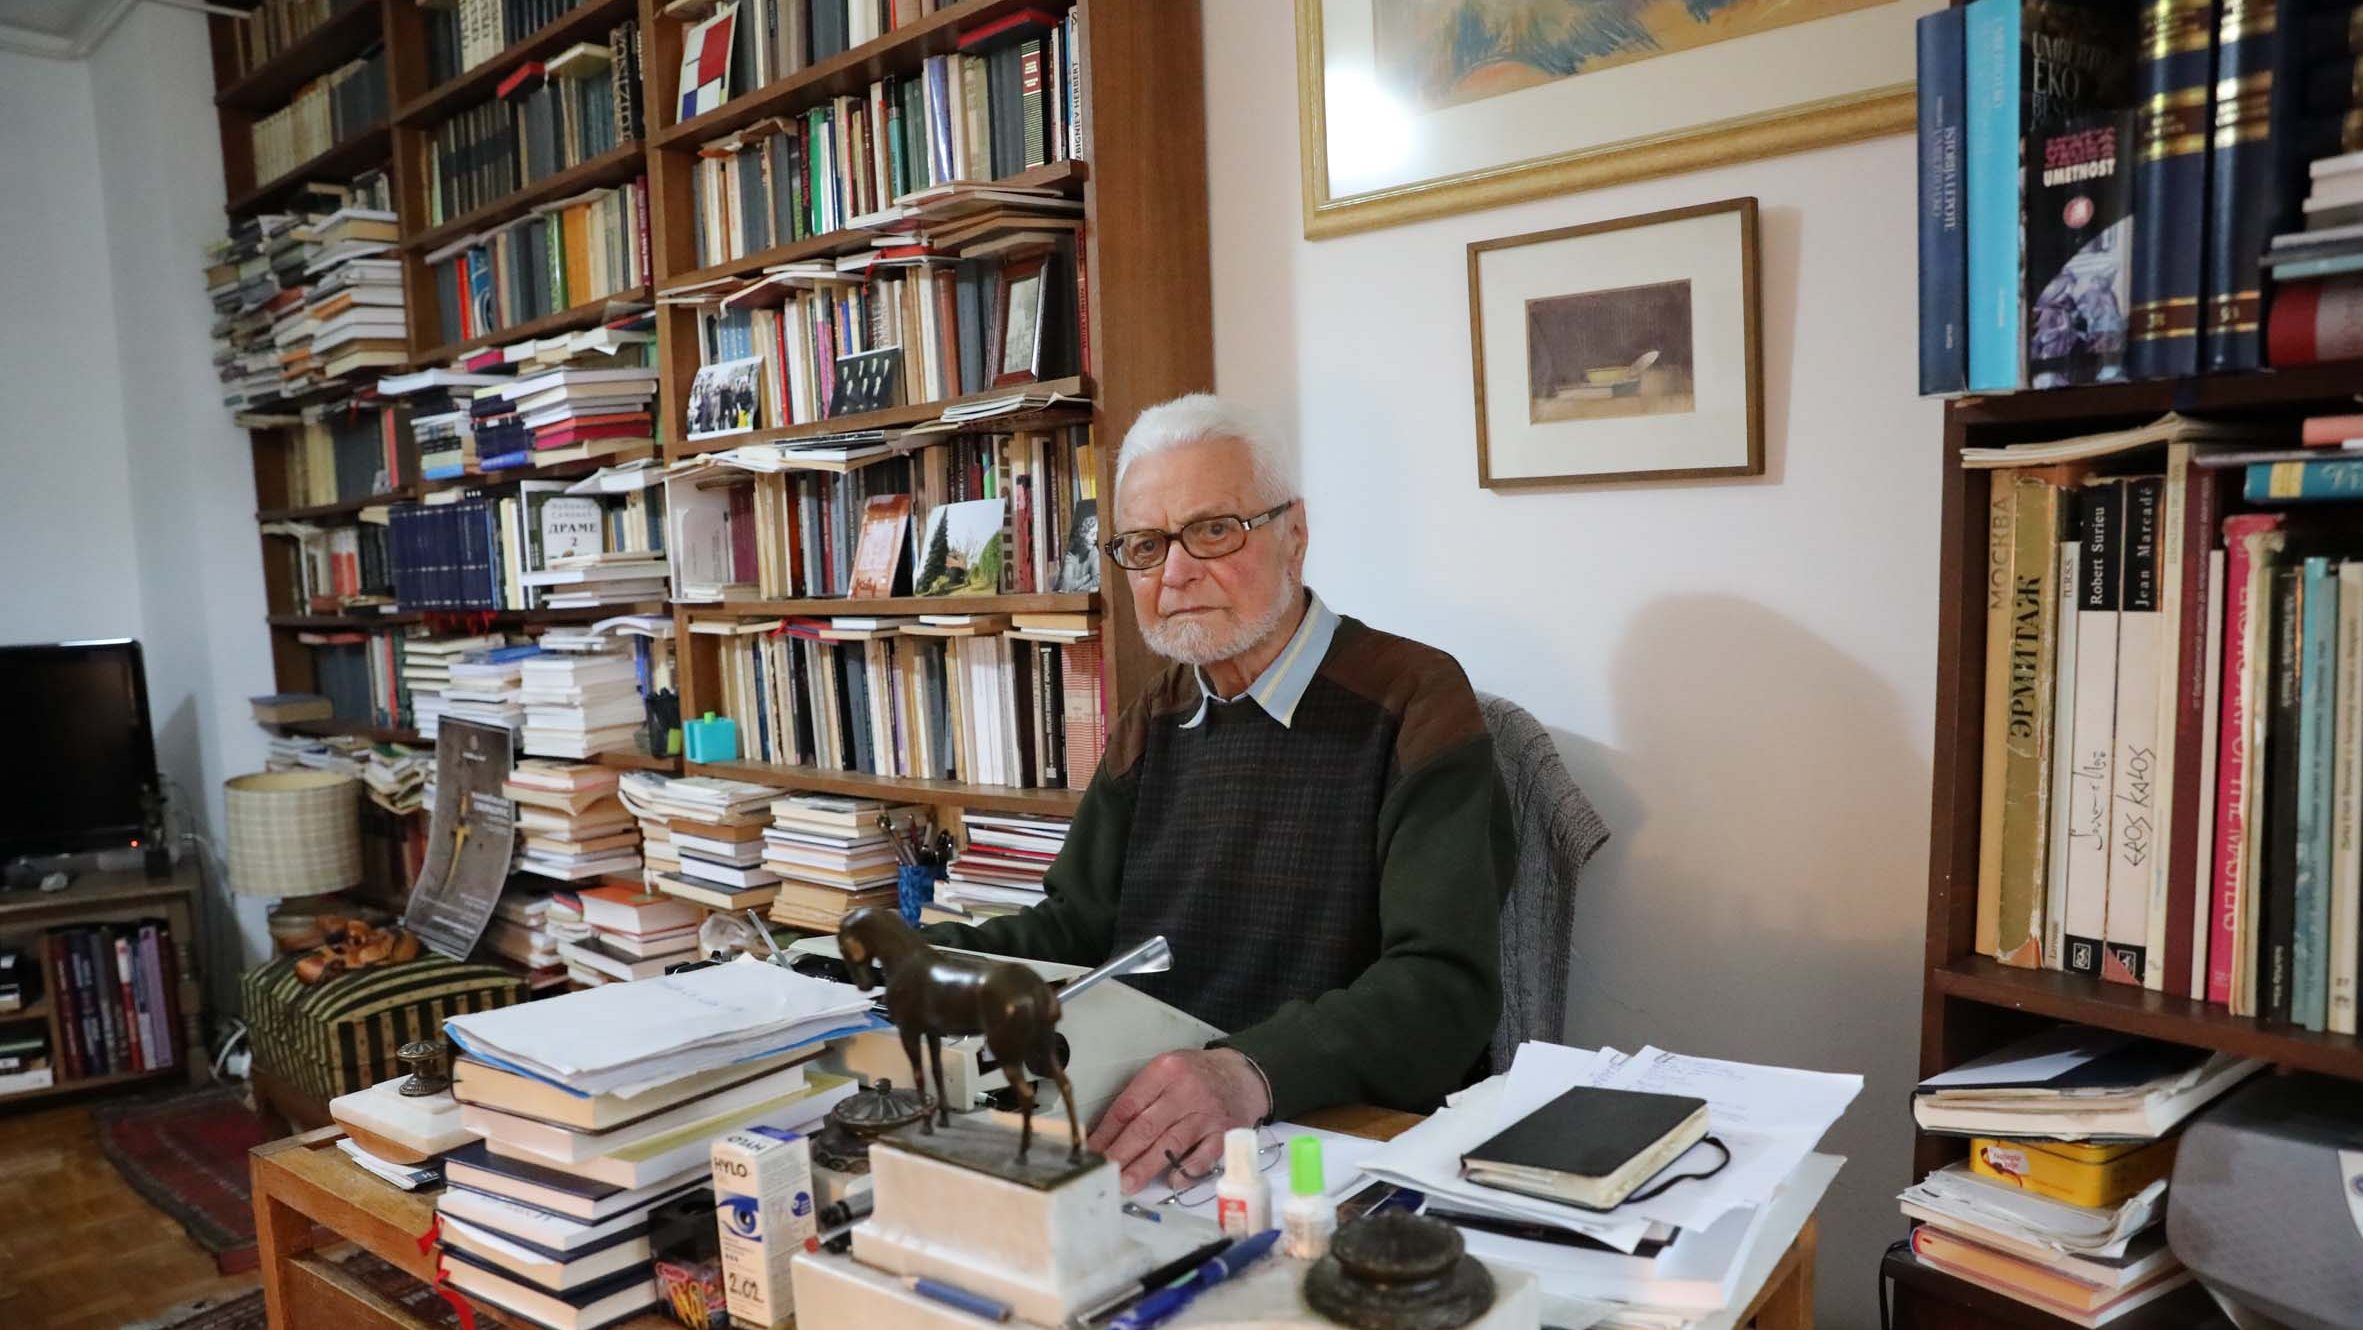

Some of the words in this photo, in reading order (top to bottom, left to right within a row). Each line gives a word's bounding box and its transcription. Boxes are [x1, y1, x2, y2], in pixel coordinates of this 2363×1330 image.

[1072, 61, 1081, 108] HERBERT
[2034, 58, 2079, 102] EKO
[2043, 158, 2116, 188] UMETNOST
[548, 523, 597, 535] ДРАМЕ
[570, 537, 579, 547] 2
[2091, 506, 2106, 553] Surieu
[2135, 487, 2153, 557] Marcadé
[1990, 496, 2010, 611] МОСКВА
[2090, 558, 2104, 606] Robert
[2135, 570, 2151, 607] Jean
[2010, 575, 2041, 738] ЭРМИТАЖ
[2223, 828, 2242, 932] MASTERS
[727, 1134, 767, 1151] HYLO
[713, 1155, 748, 1179] HYLO
